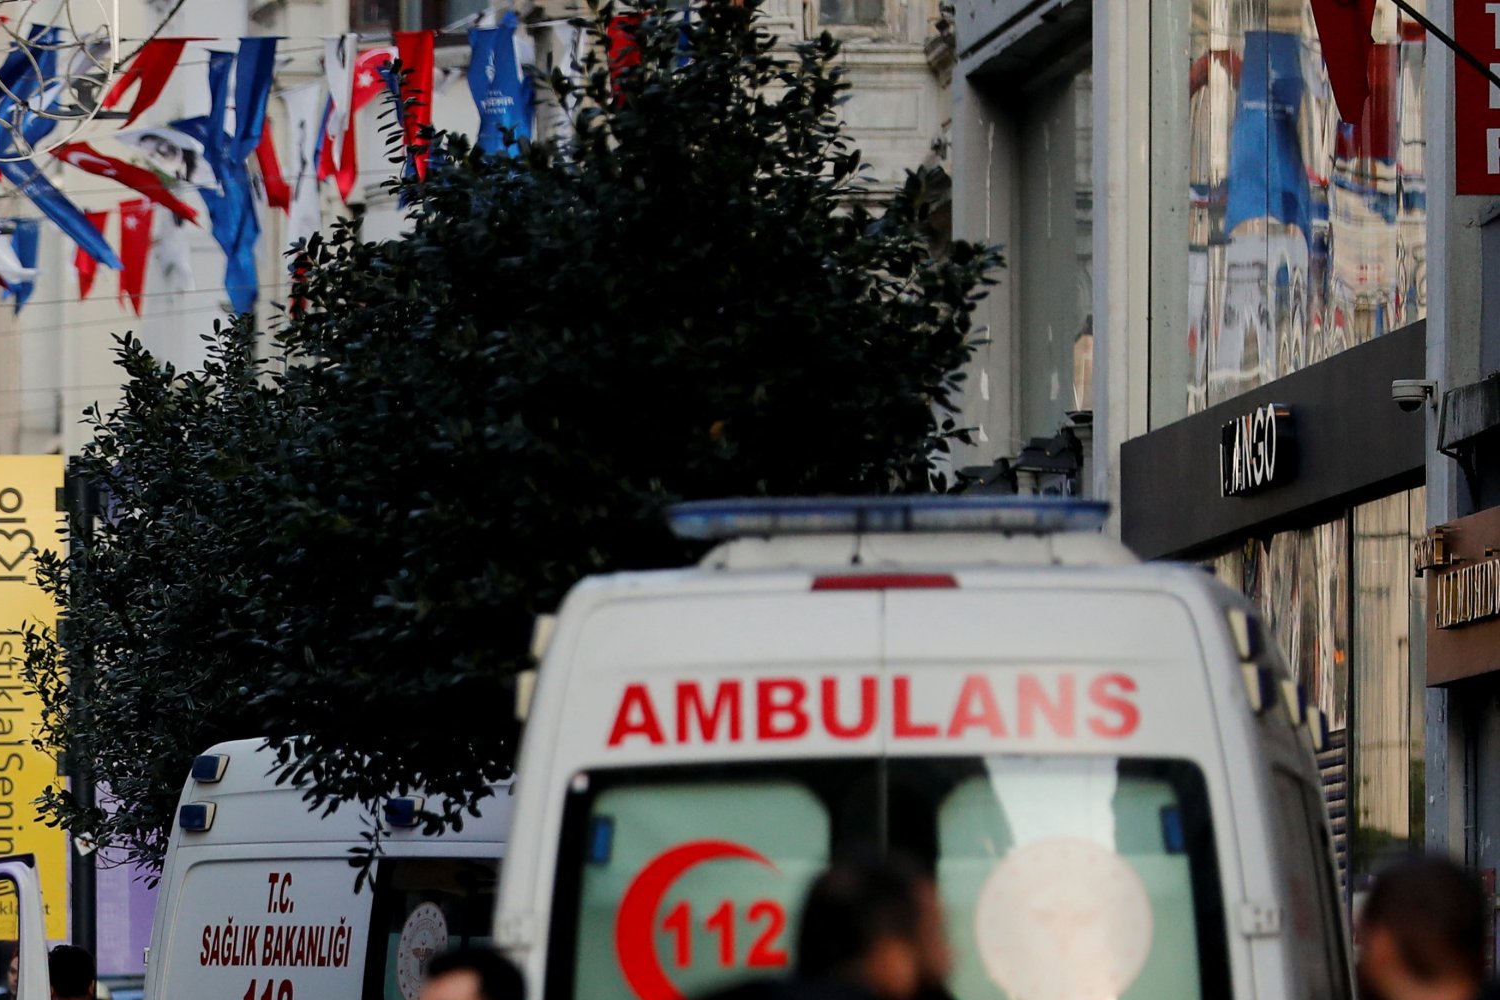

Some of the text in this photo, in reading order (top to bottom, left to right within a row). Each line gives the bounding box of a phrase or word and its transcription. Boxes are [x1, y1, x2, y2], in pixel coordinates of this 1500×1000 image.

[607, 673, 1141, 746] AMBULANS
[268, 873, 294, 913] T.C.
[200, 916, 352, 968] SAĞLIK BAKANLIĞI
[662, 898, 789, 969] 112
